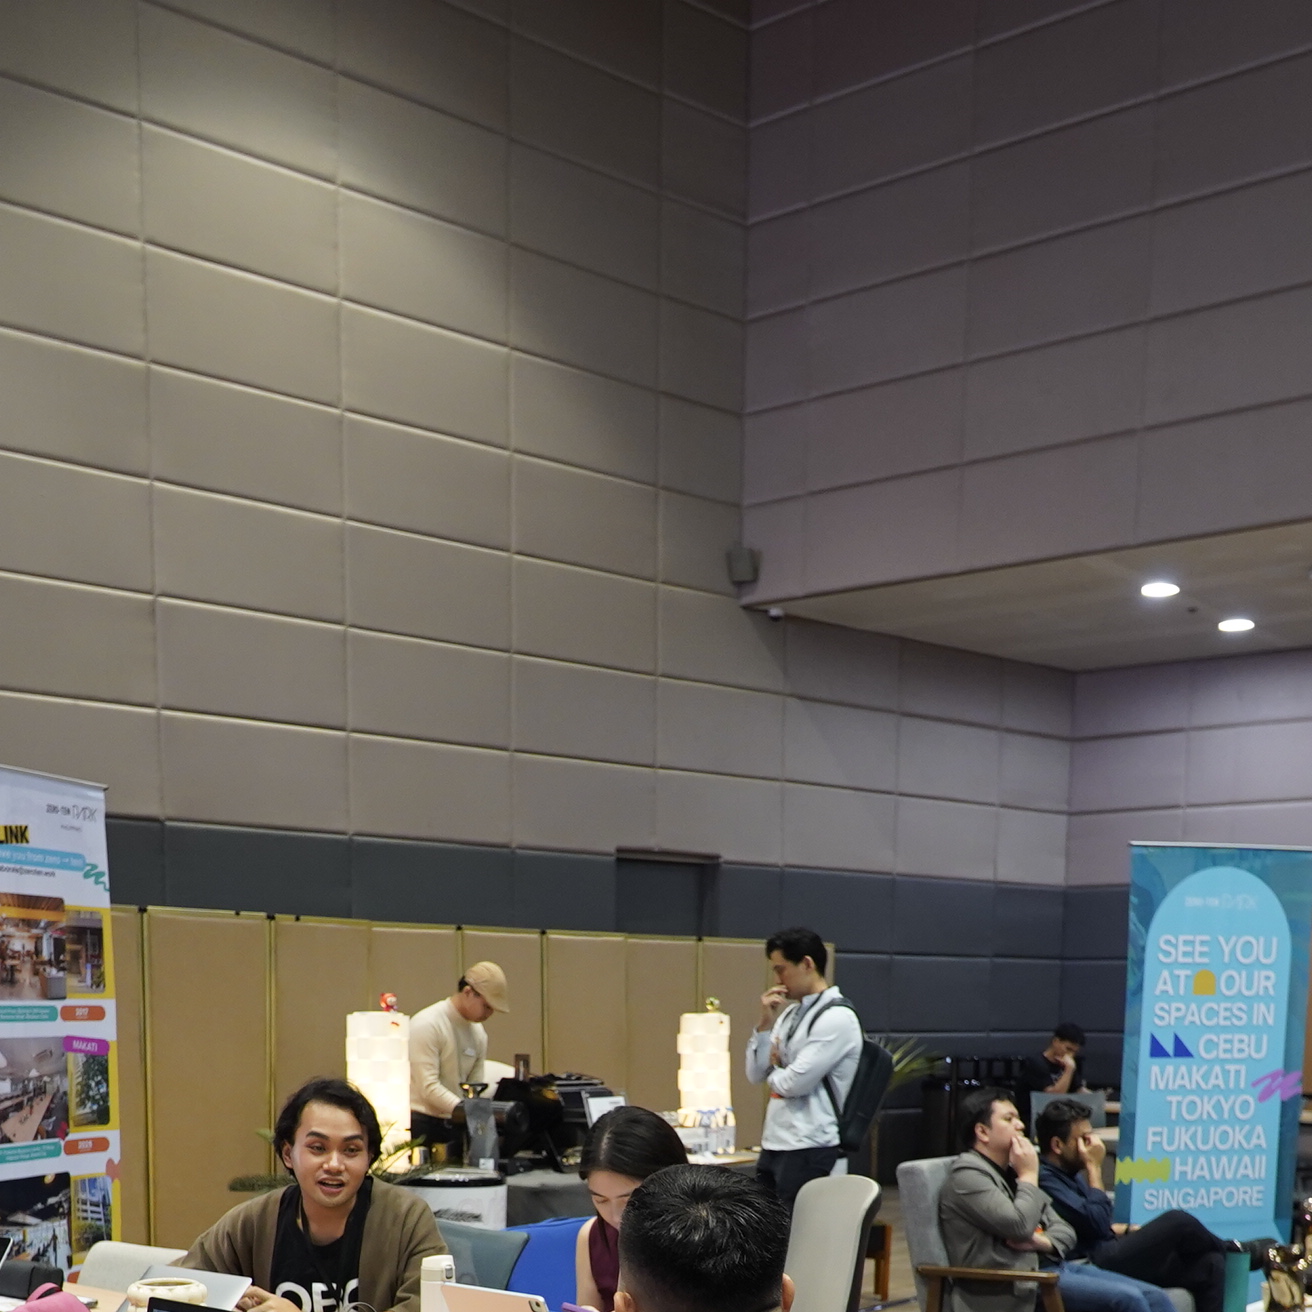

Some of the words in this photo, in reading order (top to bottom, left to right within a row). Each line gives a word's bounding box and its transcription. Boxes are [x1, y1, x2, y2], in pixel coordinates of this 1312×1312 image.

[1157, 935, 1210, 965] SEE
[1217, 936, 1278, 965] YOU
[1154, 969, 1191, 996] AT
[1220, 970, 1276, 997] OUR
[1153, 1002, 1247, 1027] SPACES
[1252, 1002, 1275, 1027] IN
[72, 1040, 98, 1052] MAKATI
[1198, 1033, 1268, 1060] CEBU
[1150, 1064, 1247, 1091] MAKATI
[1166, 1096, 1255, 1122] TOKYO
[1147, 1125, 1267, 1153] FUKUOKA
[1174, 1156, 1266, 1182] HAWAII
[1143, 1186, 1264, 1211] SINGAPORE
